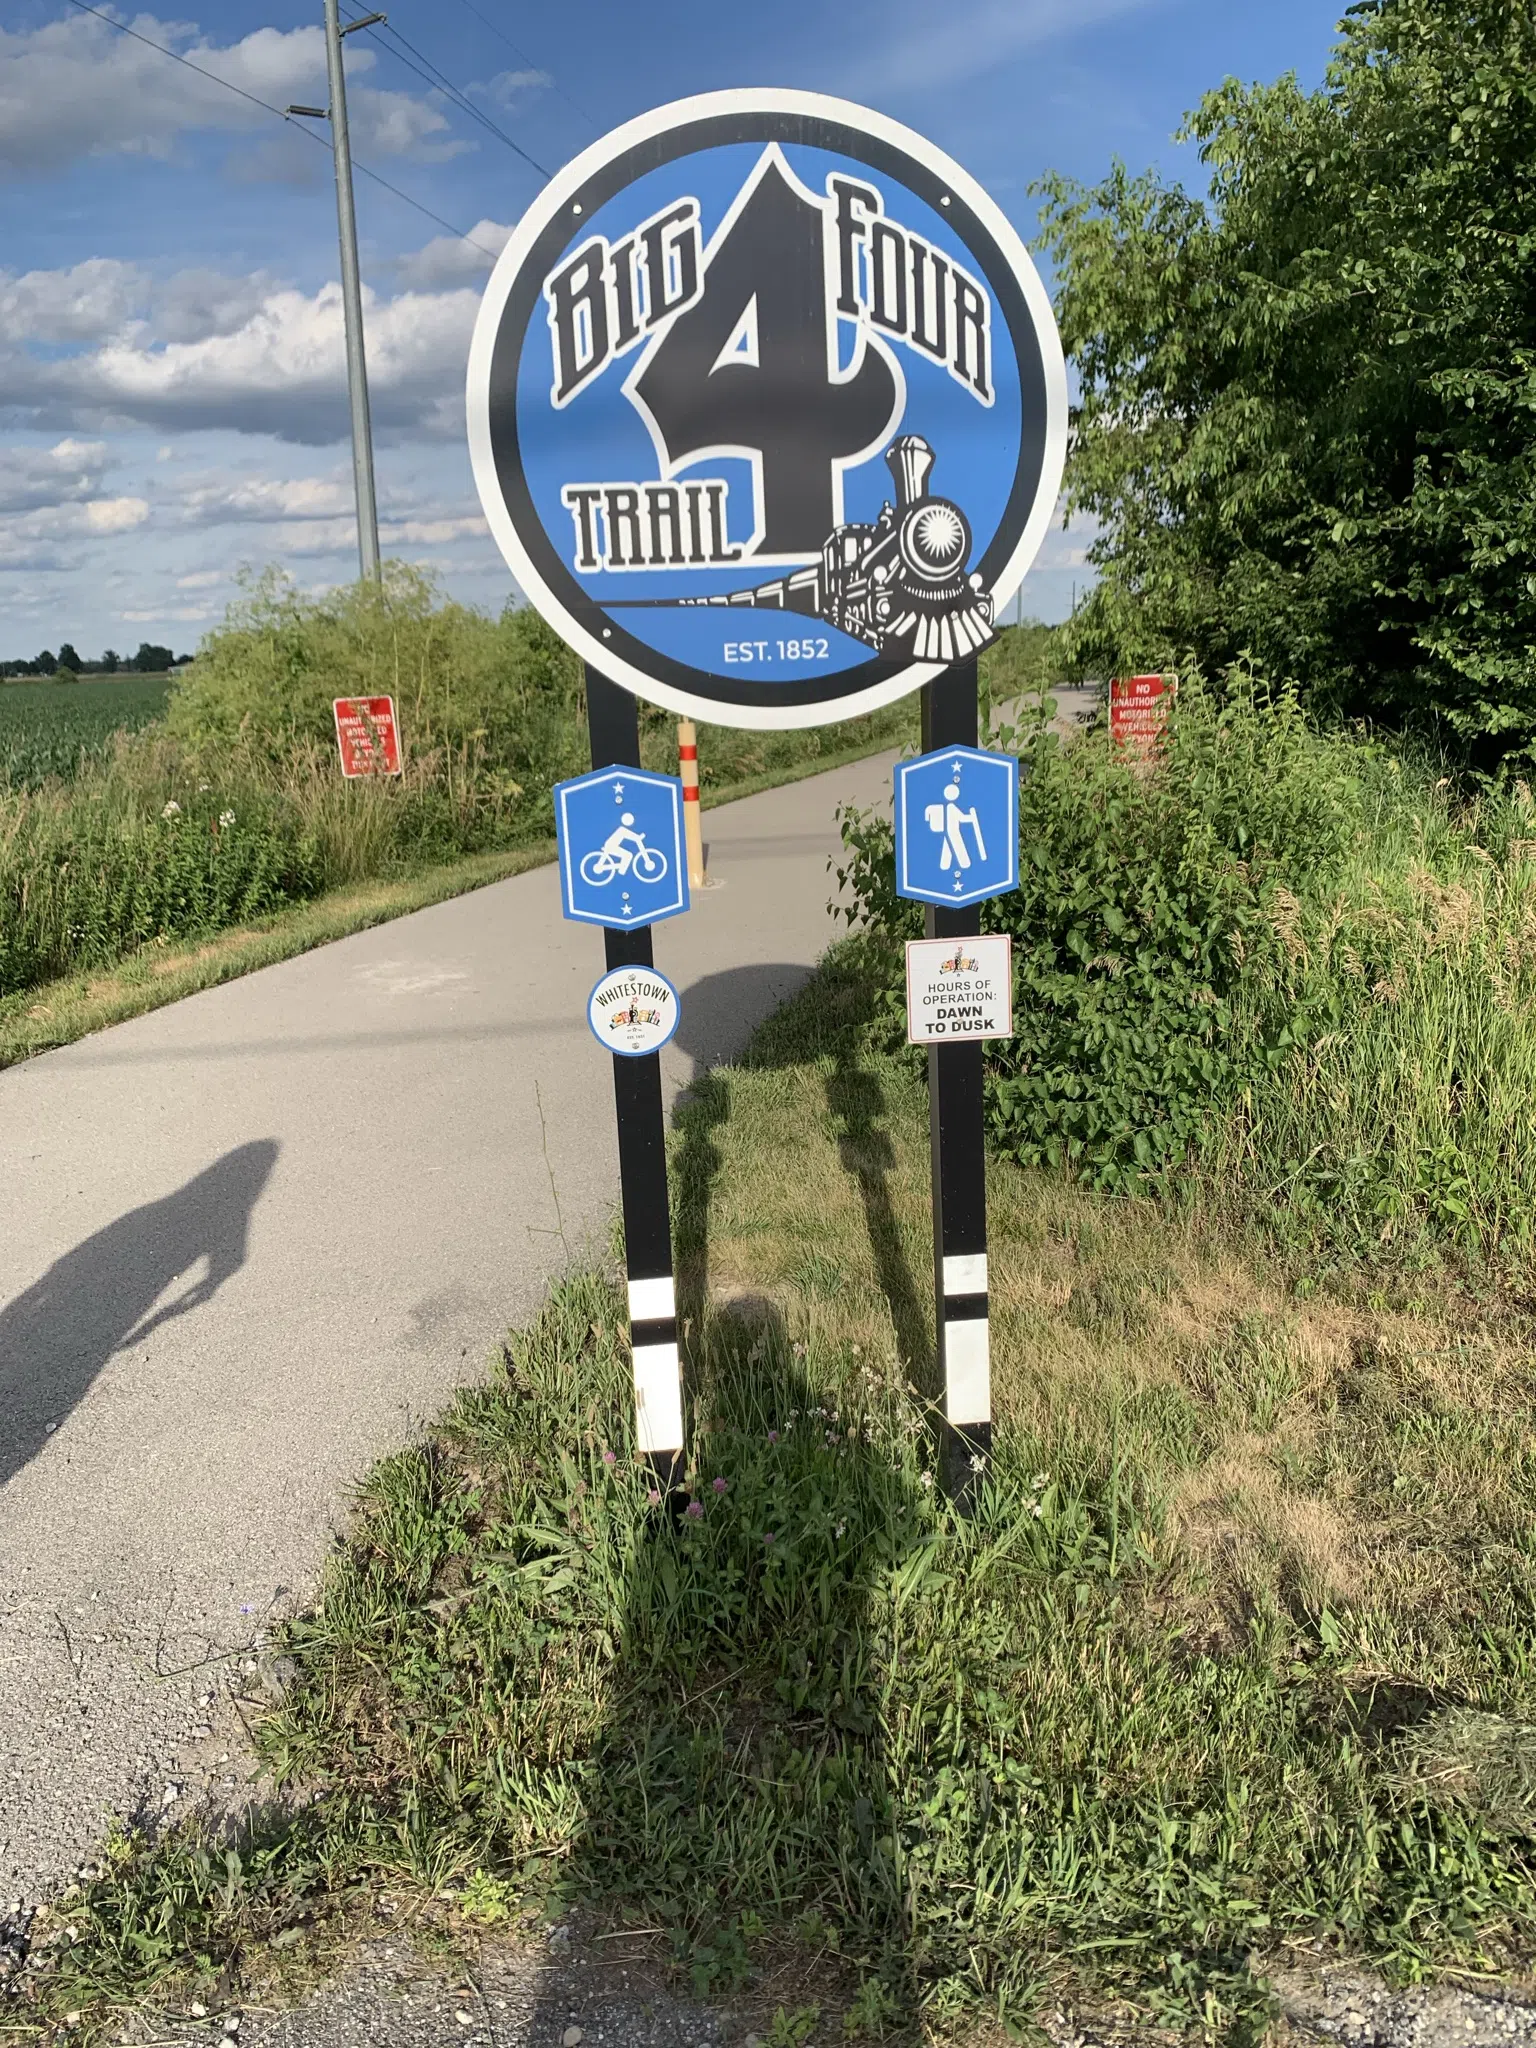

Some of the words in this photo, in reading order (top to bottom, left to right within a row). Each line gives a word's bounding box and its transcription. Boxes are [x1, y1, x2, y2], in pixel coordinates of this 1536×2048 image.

[544, 197, 704, 409] BIG
[827, 173, 994, 407] FOUR
[622, 141, 906, 562] 4
[562, 481, 743, 571] TRAIL
[724, 641, 772, 662] EST.
[776, 638, 829, 660] 1852
[1136, 684, 1150, 694] NO
[1113, 696, 1171, 707] UNAUTHORI
[339, 714, 392, 726] UNAUTRIZED
[1120, 709, 1167, 719] MOTORIED
[347, 726, 387, 737] MOTOED
[351, 736, 386, 748] VEHICS
[928, 981, 971, 993] HOURS
[975, 980, 991, 990] OF
[596, 983, 670, 1007] WHITESTOWN
[923, 992, 997, 1005] OPERATION:
[937, 1006, 982, 1019] DAWN
[925, 1022, 946, 1034] TO
[951, 1019, 995, 1032] DUSK
